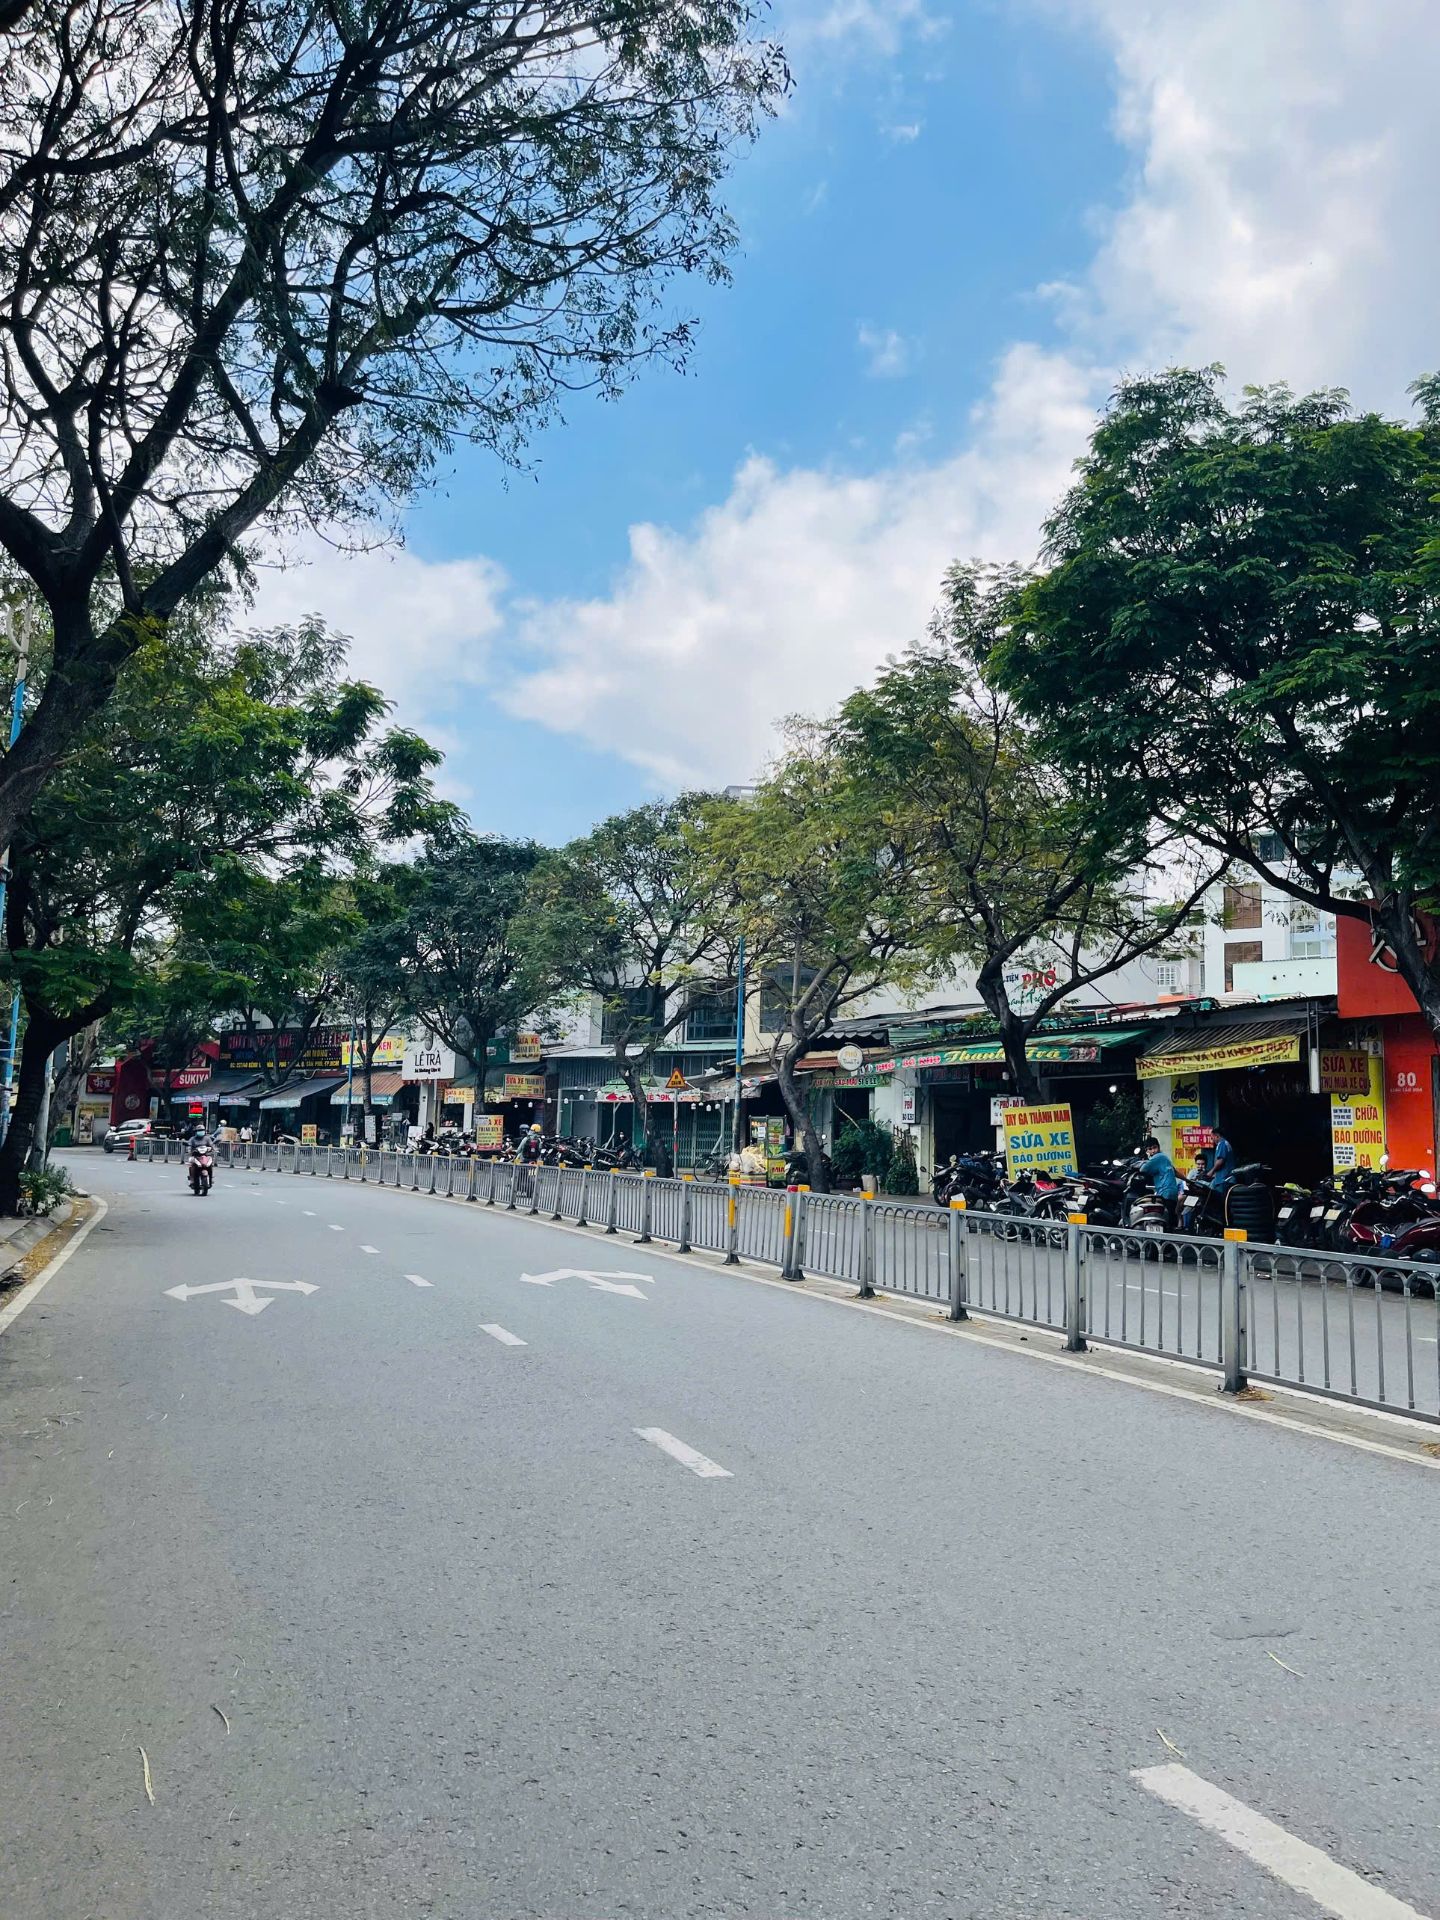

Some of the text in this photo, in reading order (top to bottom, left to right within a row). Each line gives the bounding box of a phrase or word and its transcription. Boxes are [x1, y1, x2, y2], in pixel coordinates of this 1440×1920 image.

[415, 1050, 441, 1067] LÊ TRÀ
[1350, 1055, 1365, 1073] XE
[1397, 1072, 1416, 1088] 80
[1005, 1113, 1017, 1127] TAY
[1018, 1112, 1029, 1126] GA
[1053, 1109, 1071, 1122] NAM
[1010, 1130, 1071, 1150] SỬA XE
[1359, 1153, 1371, 1168] GA
